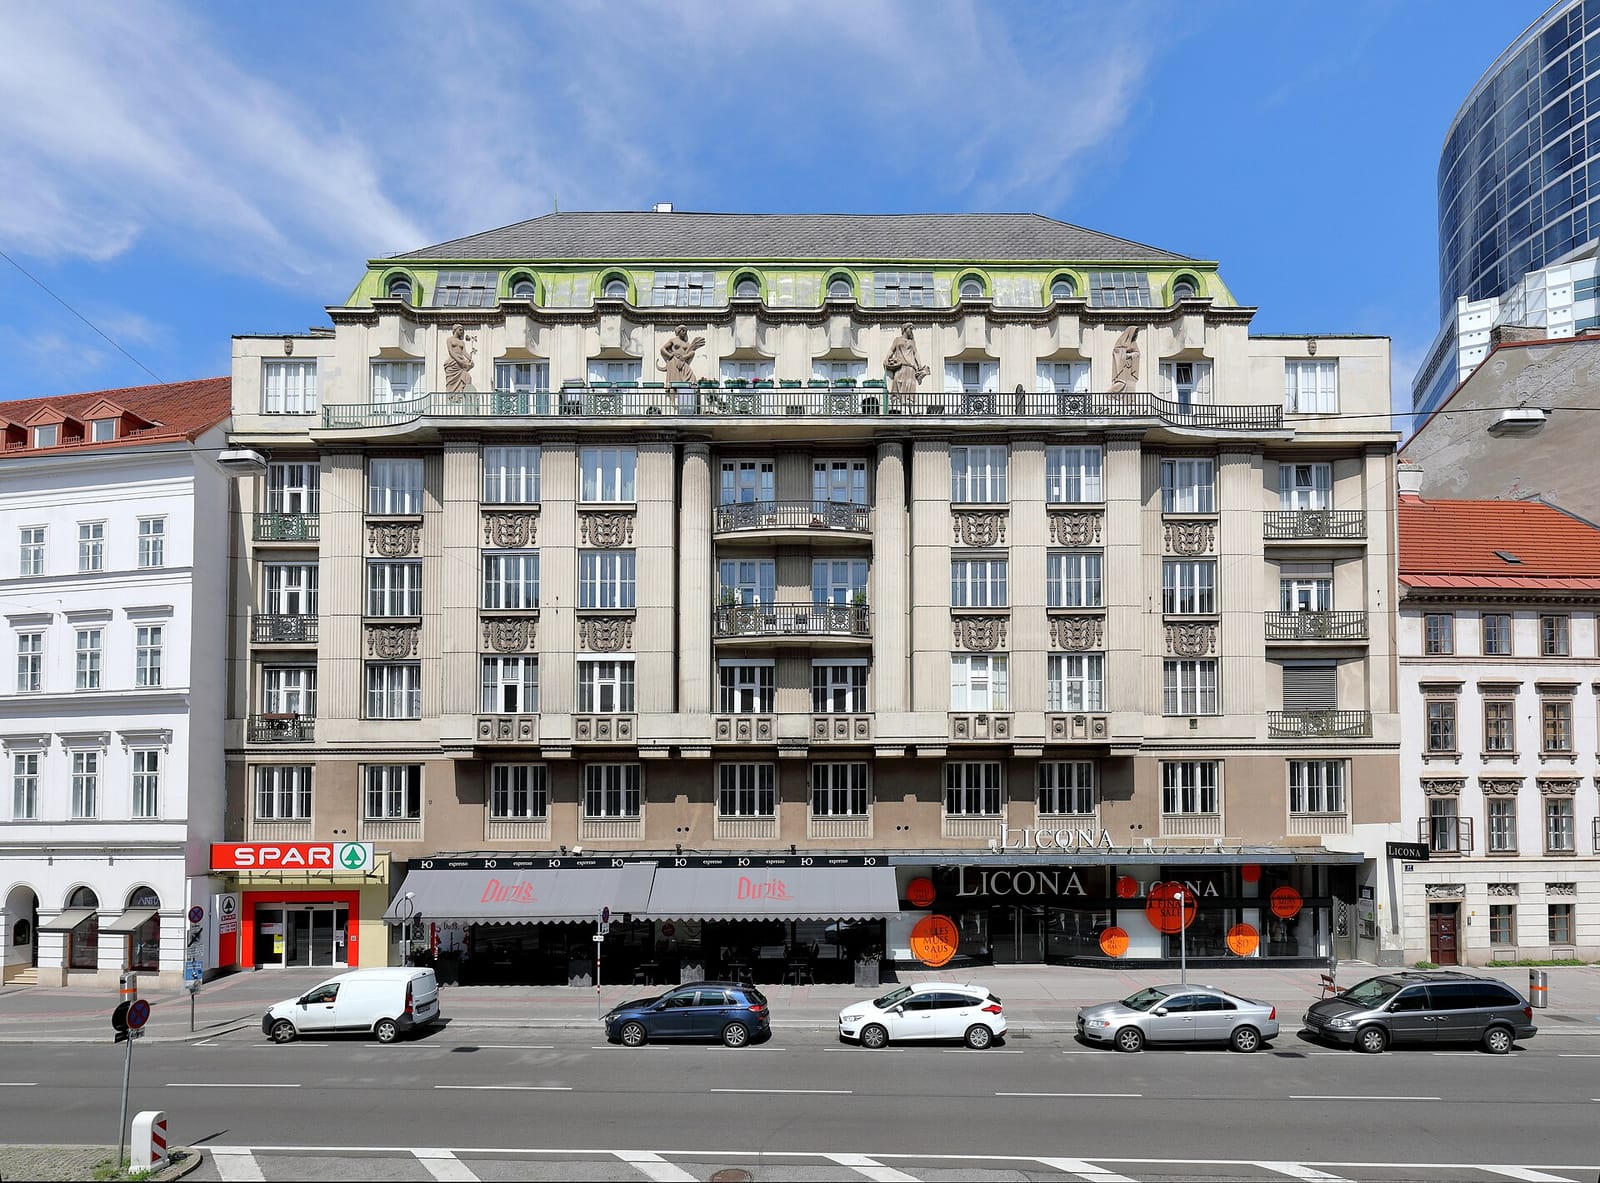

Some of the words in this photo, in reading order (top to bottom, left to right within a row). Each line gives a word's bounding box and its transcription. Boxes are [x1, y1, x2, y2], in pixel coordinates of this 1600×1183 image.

[1001, 823, 1114, 850] LICONA
[234, 847, 331, 866] SPAR
[1388, 845, 1421, 857] LICONA
[955, 864, 1088, 897] LICONA
